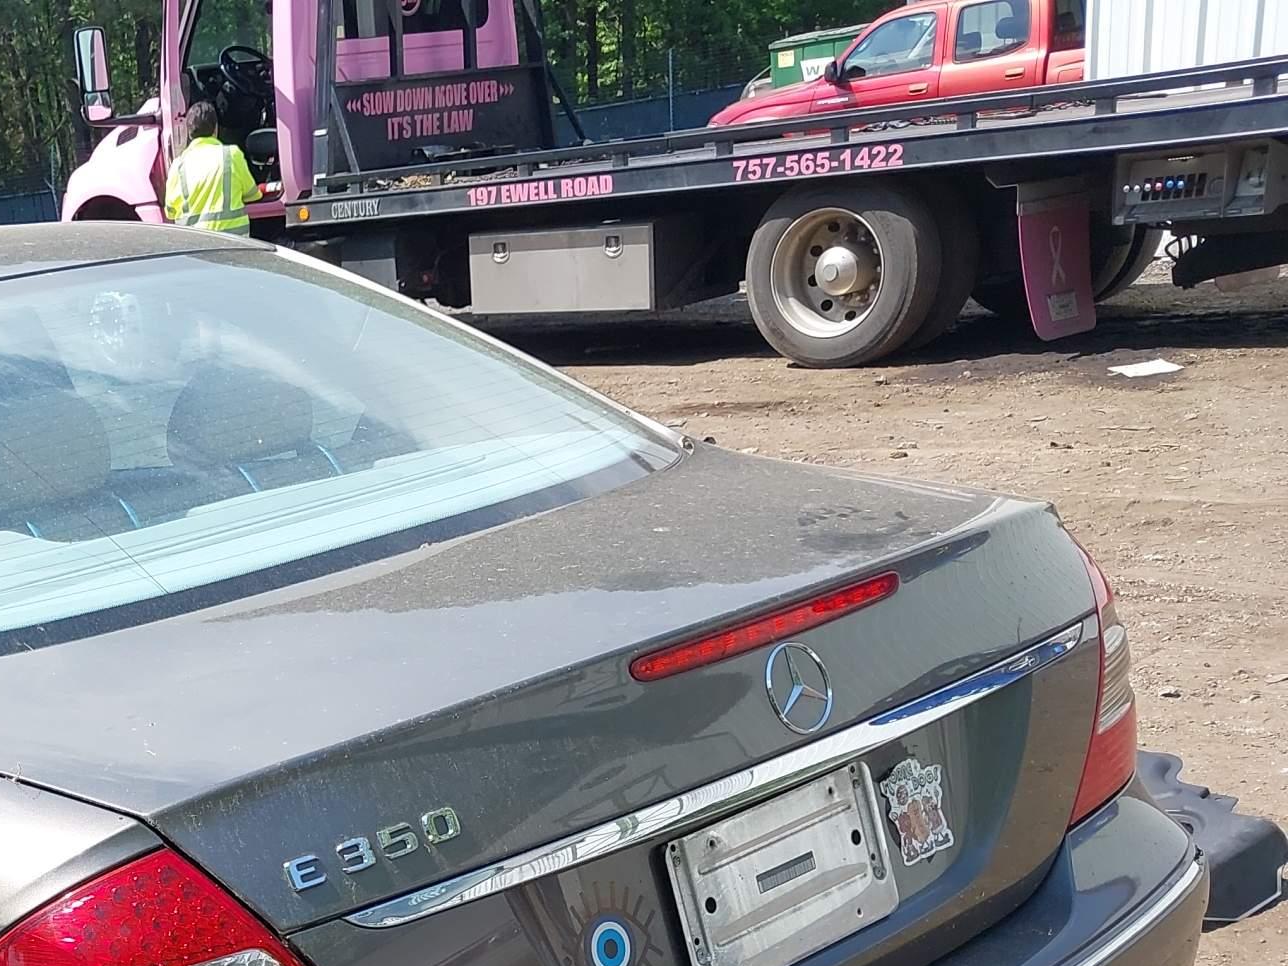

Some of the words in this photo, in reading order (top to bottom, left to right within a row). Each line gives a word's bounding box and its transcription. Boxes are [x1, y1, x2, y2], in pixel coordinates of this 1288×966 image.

[362, 90, 395, 117] SLOW
[397, 85, 433, 113] DOWN
[435, 82, 468, 110] MOVE
[469, 80, 498, 104] OVER
[387, 115, 412, 141] IT'S
[414, 112, 441, 138] THE
[443, 109, 474, 134] LAW
[732, 143, 904, 182] 757-565-1422
[467, 186, 500, 207] 197
[500, 181, 557, 205] EWELL
[560, 175, 613, 198] ROAD
[331, 198, 381, 220] CENTURY
[283, 854, 328, 893] E
[336, 807, 461, 875] 350
